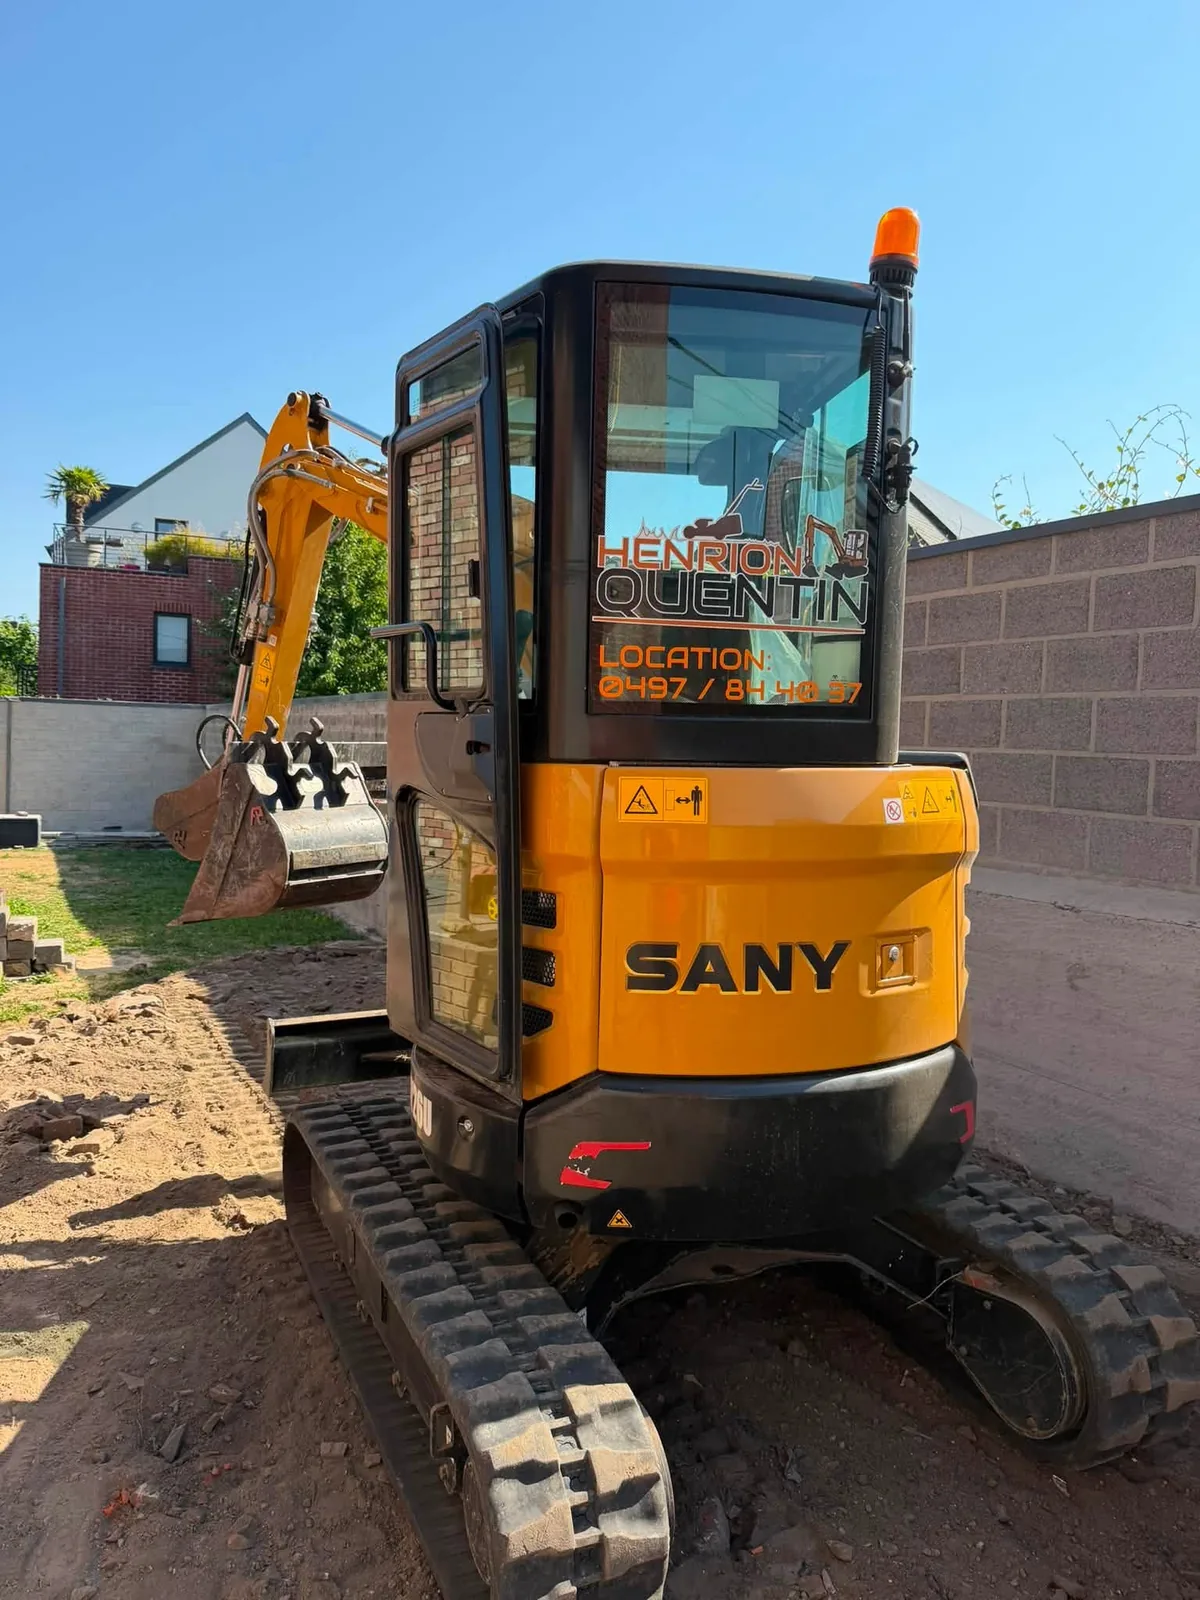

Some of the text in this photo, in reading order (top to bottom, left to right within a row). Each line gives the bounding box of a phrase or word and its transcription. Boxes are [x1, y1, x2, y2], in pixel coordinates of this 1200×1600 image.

[597, 535, 801, 577] HENRION
[596, 567, 869, 625] QUENTIN
[599, 644, 772, 671] LOCATION:
[599, 675, 688, 700] 0497
[725, 678, 765, 701] 84
[828, 681, 862, 704] 37
[624, 940, 852, 995] SANY
